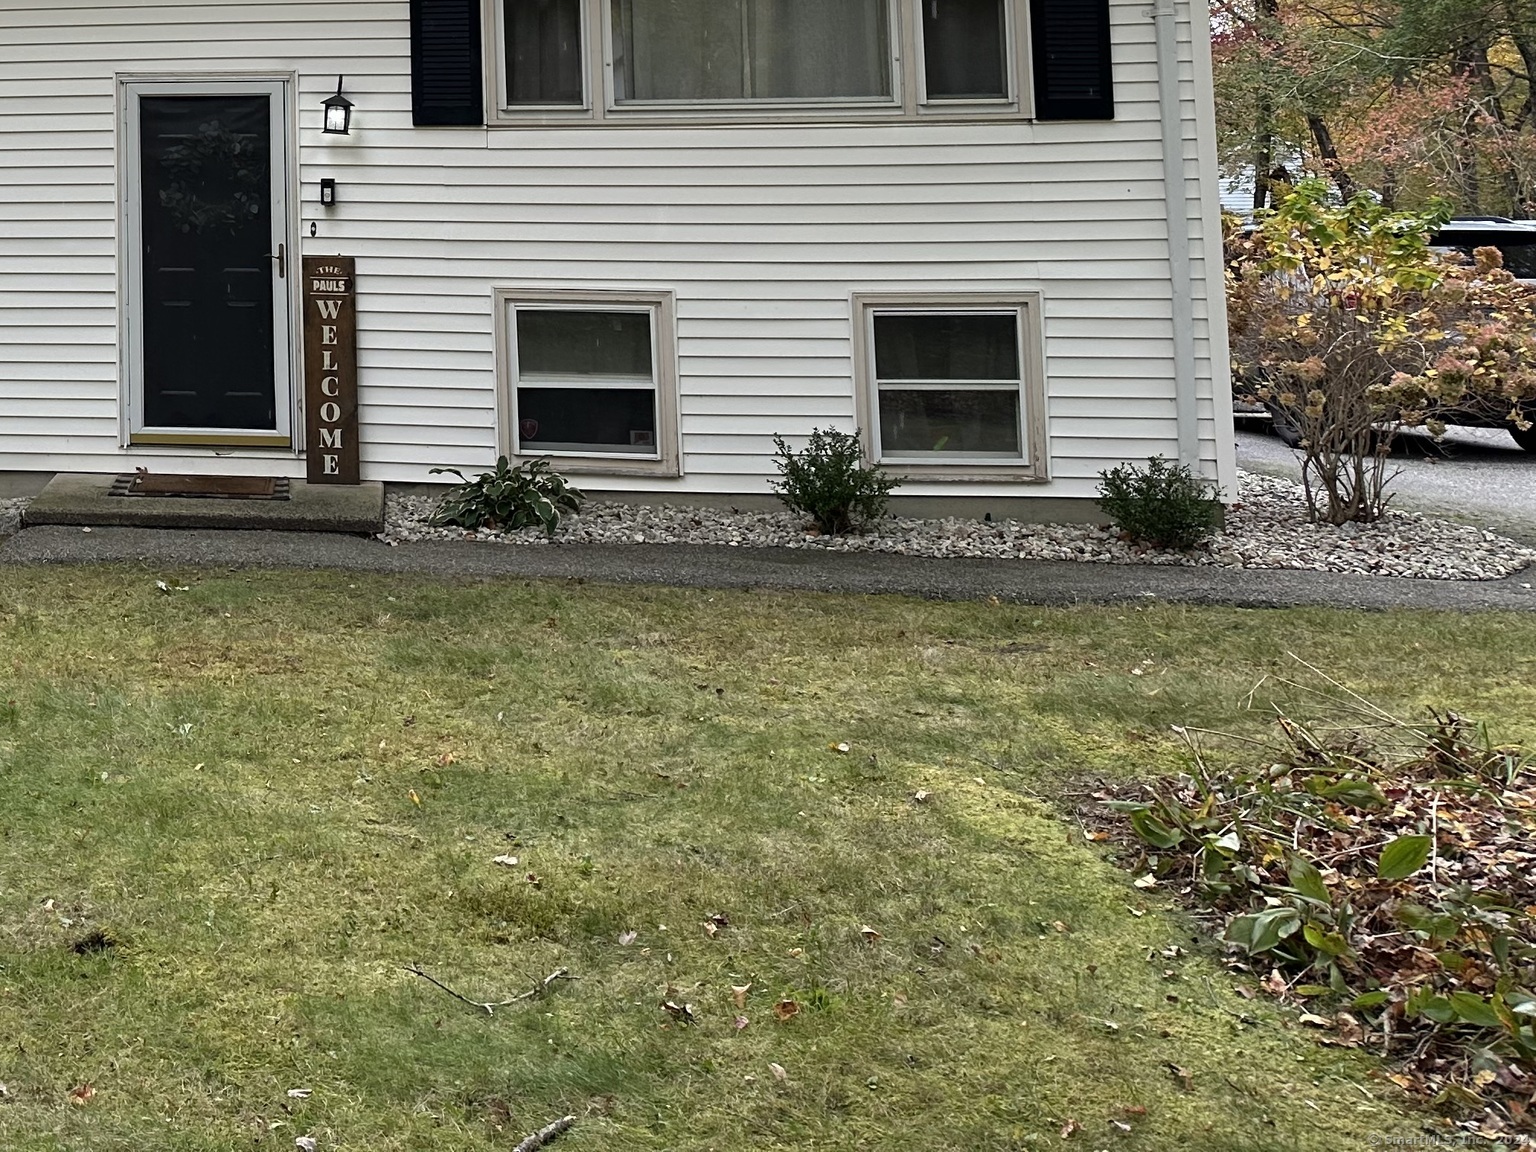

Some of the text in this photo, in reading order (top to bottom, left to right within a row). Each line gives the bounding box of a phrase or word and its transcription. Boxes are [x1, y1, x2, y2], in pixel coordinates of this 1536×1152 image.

[316, 266, 341, 275] THE
[313, 280, 345, 292] PAULS
[315, 299, 343, 475] WELCOME
